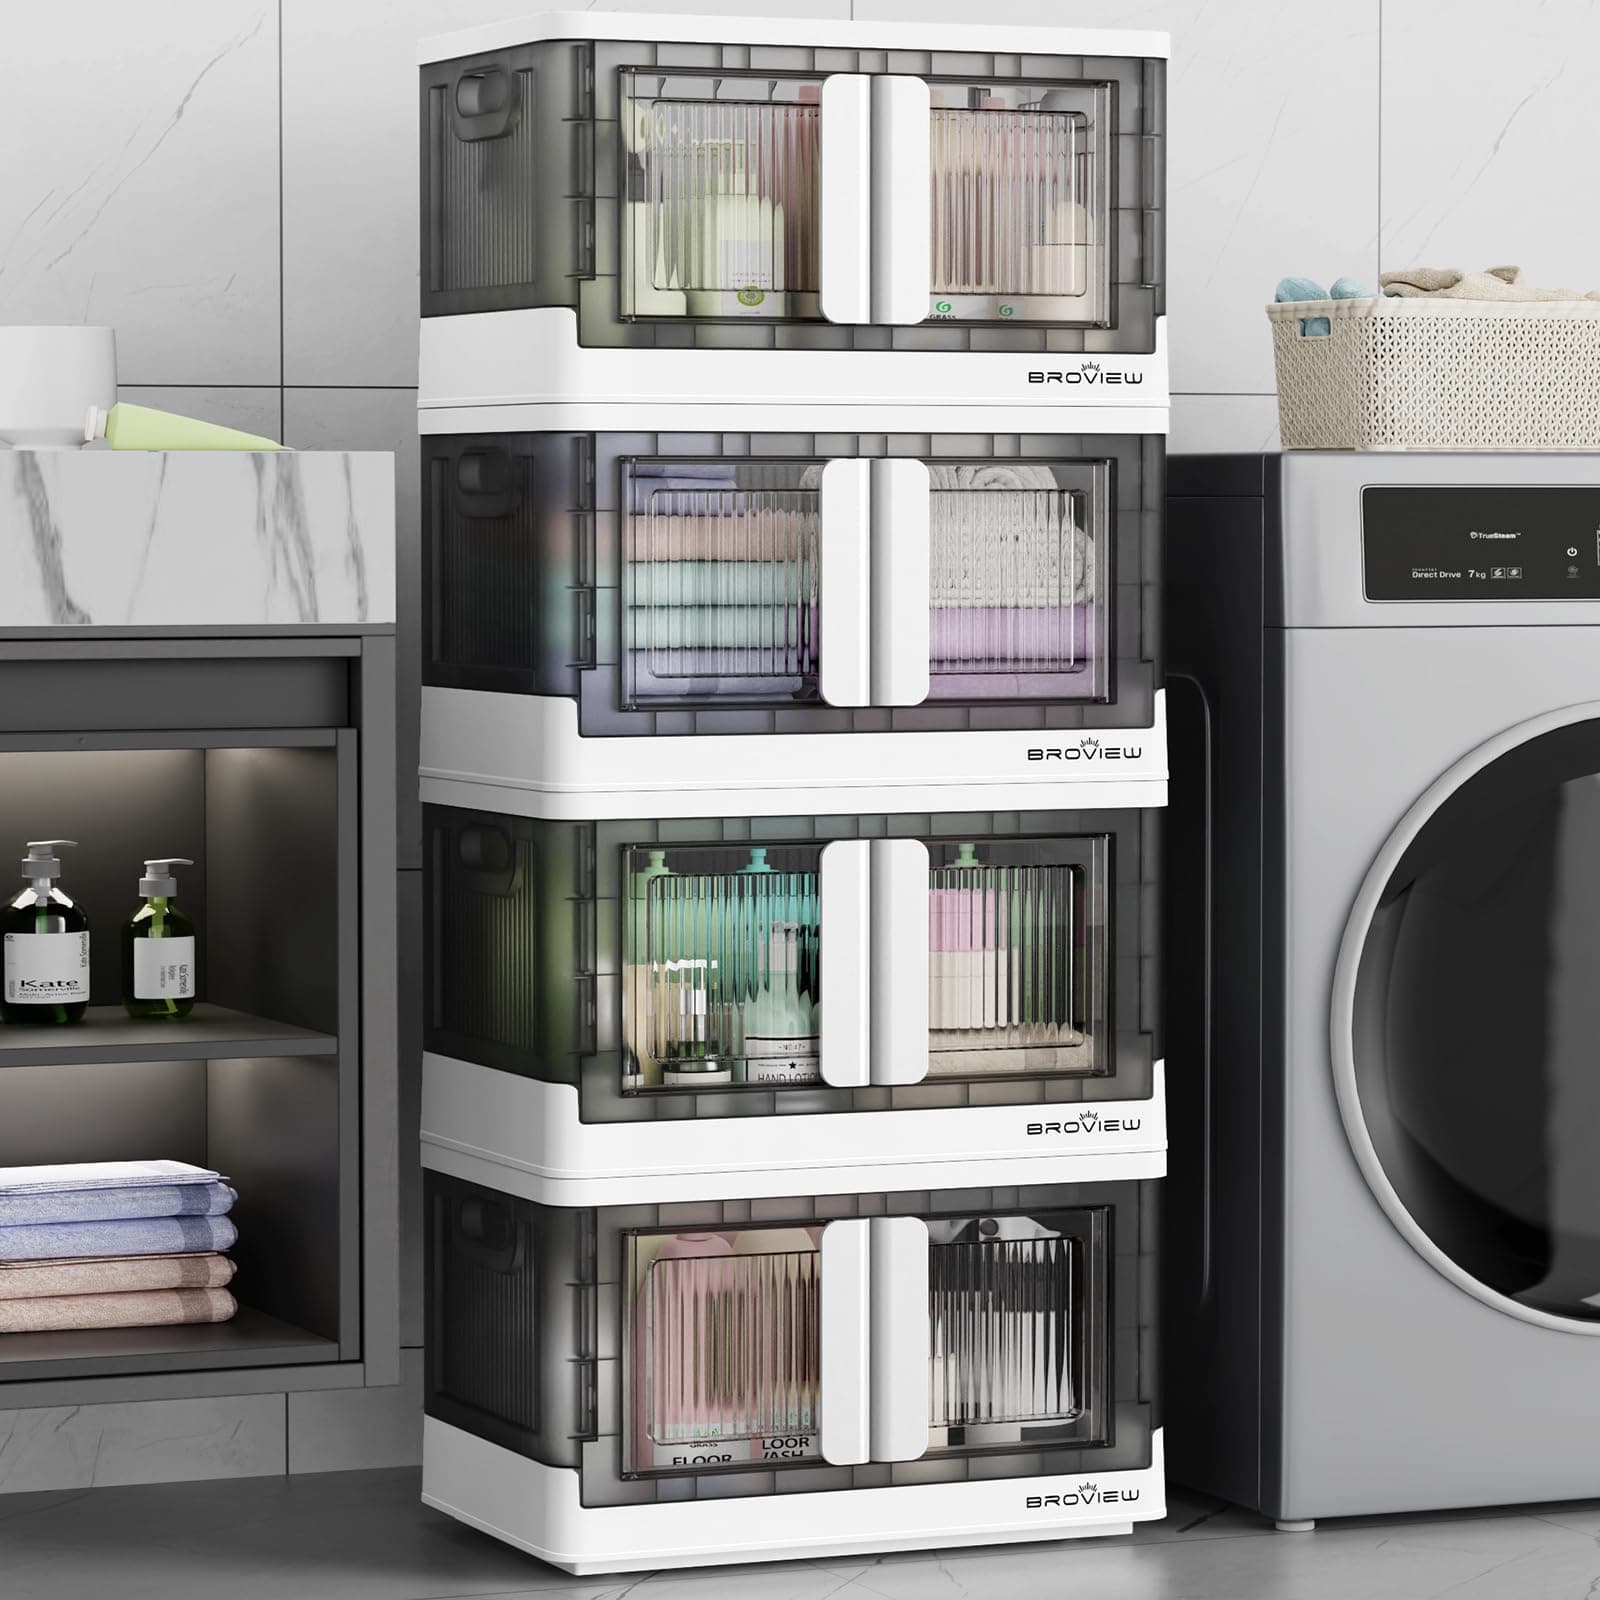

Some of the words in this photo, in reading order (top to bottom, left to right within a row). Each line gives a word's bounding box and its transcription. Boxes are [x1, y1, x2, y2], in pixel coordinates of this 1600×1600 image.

[1028, 371, 1143, 384] BROVIEW
[1412, 571, 1438, 579] Direct
[1440, 571, 1461, 579] Drive
[1027, 747, 1142, 760] BROVIEW
[20, 980, 79, 988] Kate
[758, 1072, 786, 1082] HAND
[1027, 1119, 1141, 1135] BROVIEW
[762, 1437, 810, 1450] LOOR
[1026, 1489, 1139, 1508] BROVIEW
